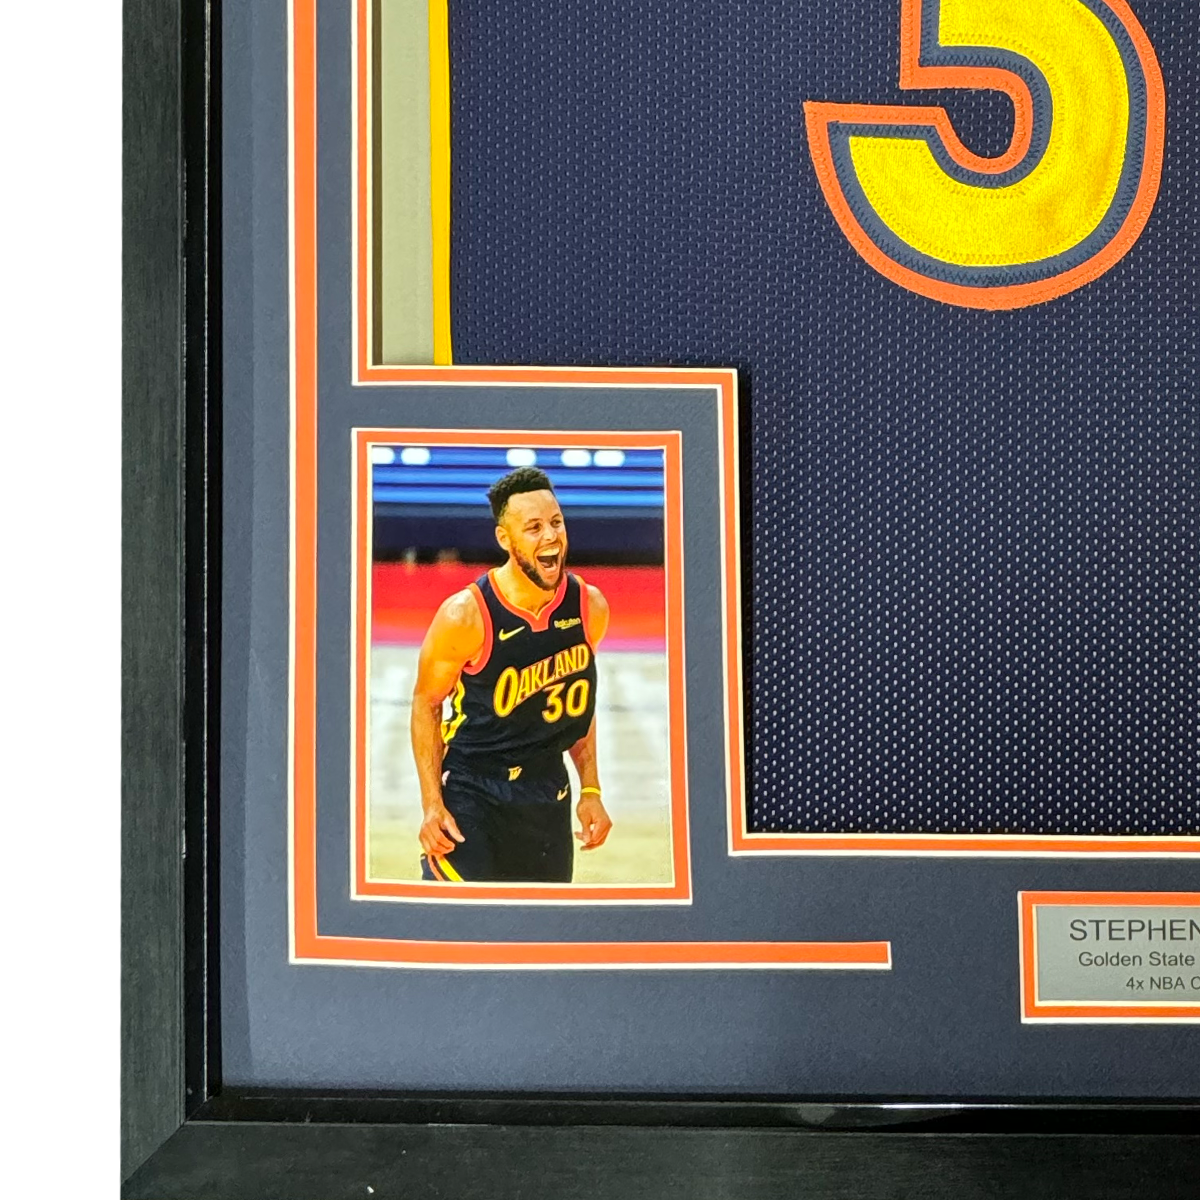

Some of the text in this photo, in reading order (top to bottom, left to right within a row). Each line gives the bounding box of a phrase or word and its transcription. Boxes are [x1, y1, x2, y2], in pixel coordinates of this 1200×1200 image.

[493, 643, 590, 718] OAKLAND
[541, 678, 590, 724] 30
[1078, 950, 1143, 968] Golden
[1148, 950, 1196, 968] State
[1125, 976, 1145, 991] 4x
[1149, 976, 1186, 991] NBA
